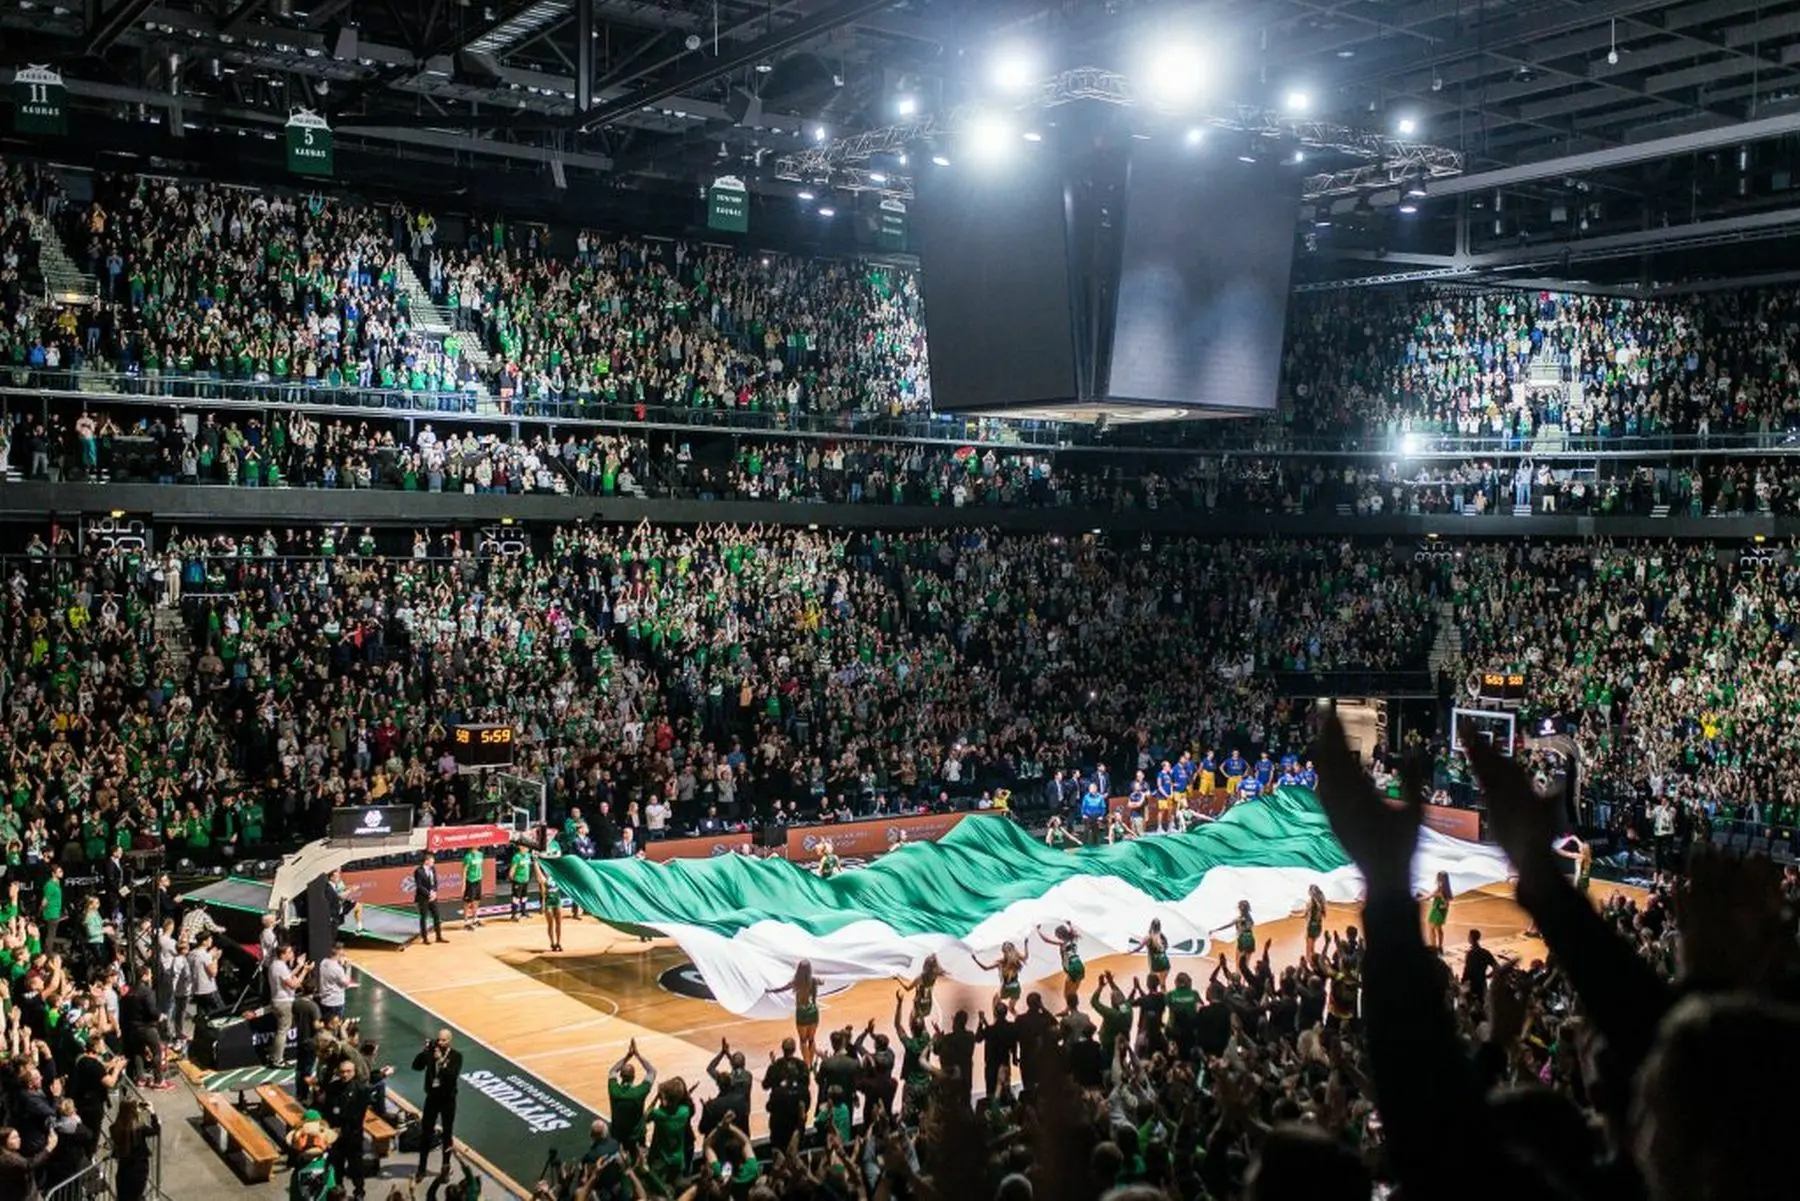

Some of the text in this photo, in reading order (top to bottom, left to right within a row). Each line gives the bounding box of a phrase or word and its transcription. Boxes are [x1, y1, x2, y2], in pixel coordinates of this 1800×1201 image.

[30, 84, 48, 103] 11
[304, 128, 314, 145] 5
[481, 729, 511, 743] 5:59
